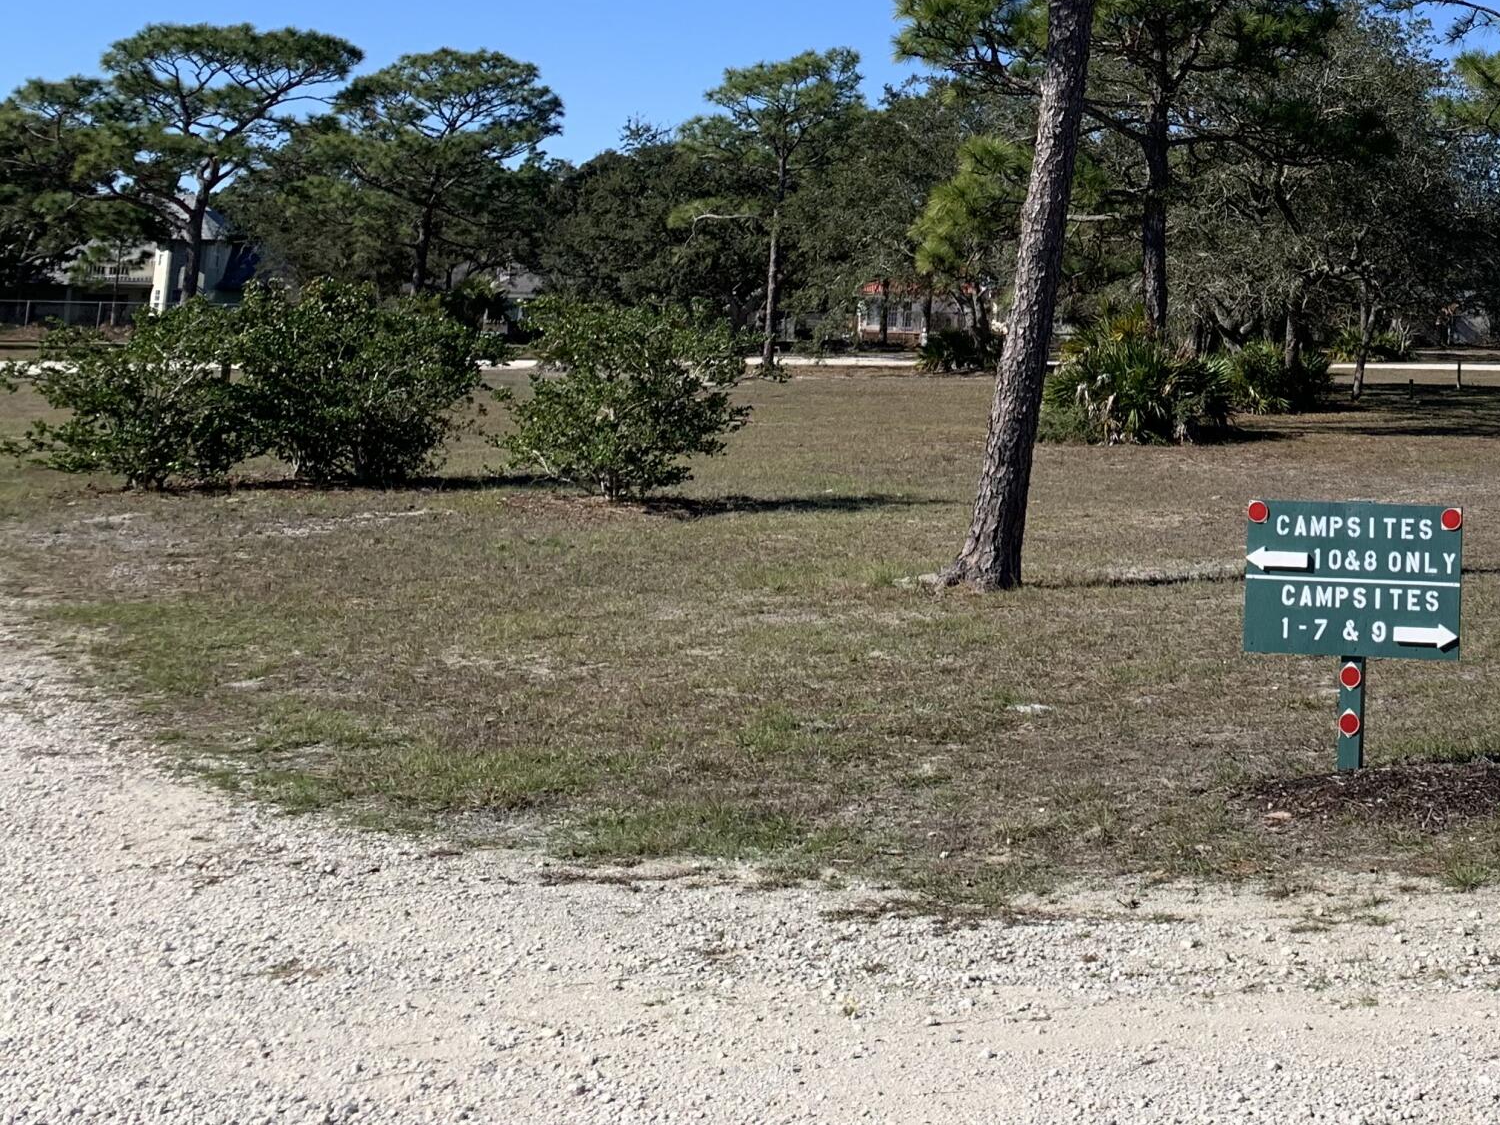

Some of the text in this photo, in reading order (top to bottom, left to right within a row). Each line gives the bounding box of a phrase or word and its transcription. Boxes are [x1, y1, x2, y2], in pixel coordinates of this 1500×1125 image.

[1275, 514, 1433, 540] CAMPSITES
[1313, 547, 1457, 574] 10&8 ONLY
[1281, 584, 1440, 611] CAMPSITES
[1281, 617, 1387, 643] 1-7 & 9
